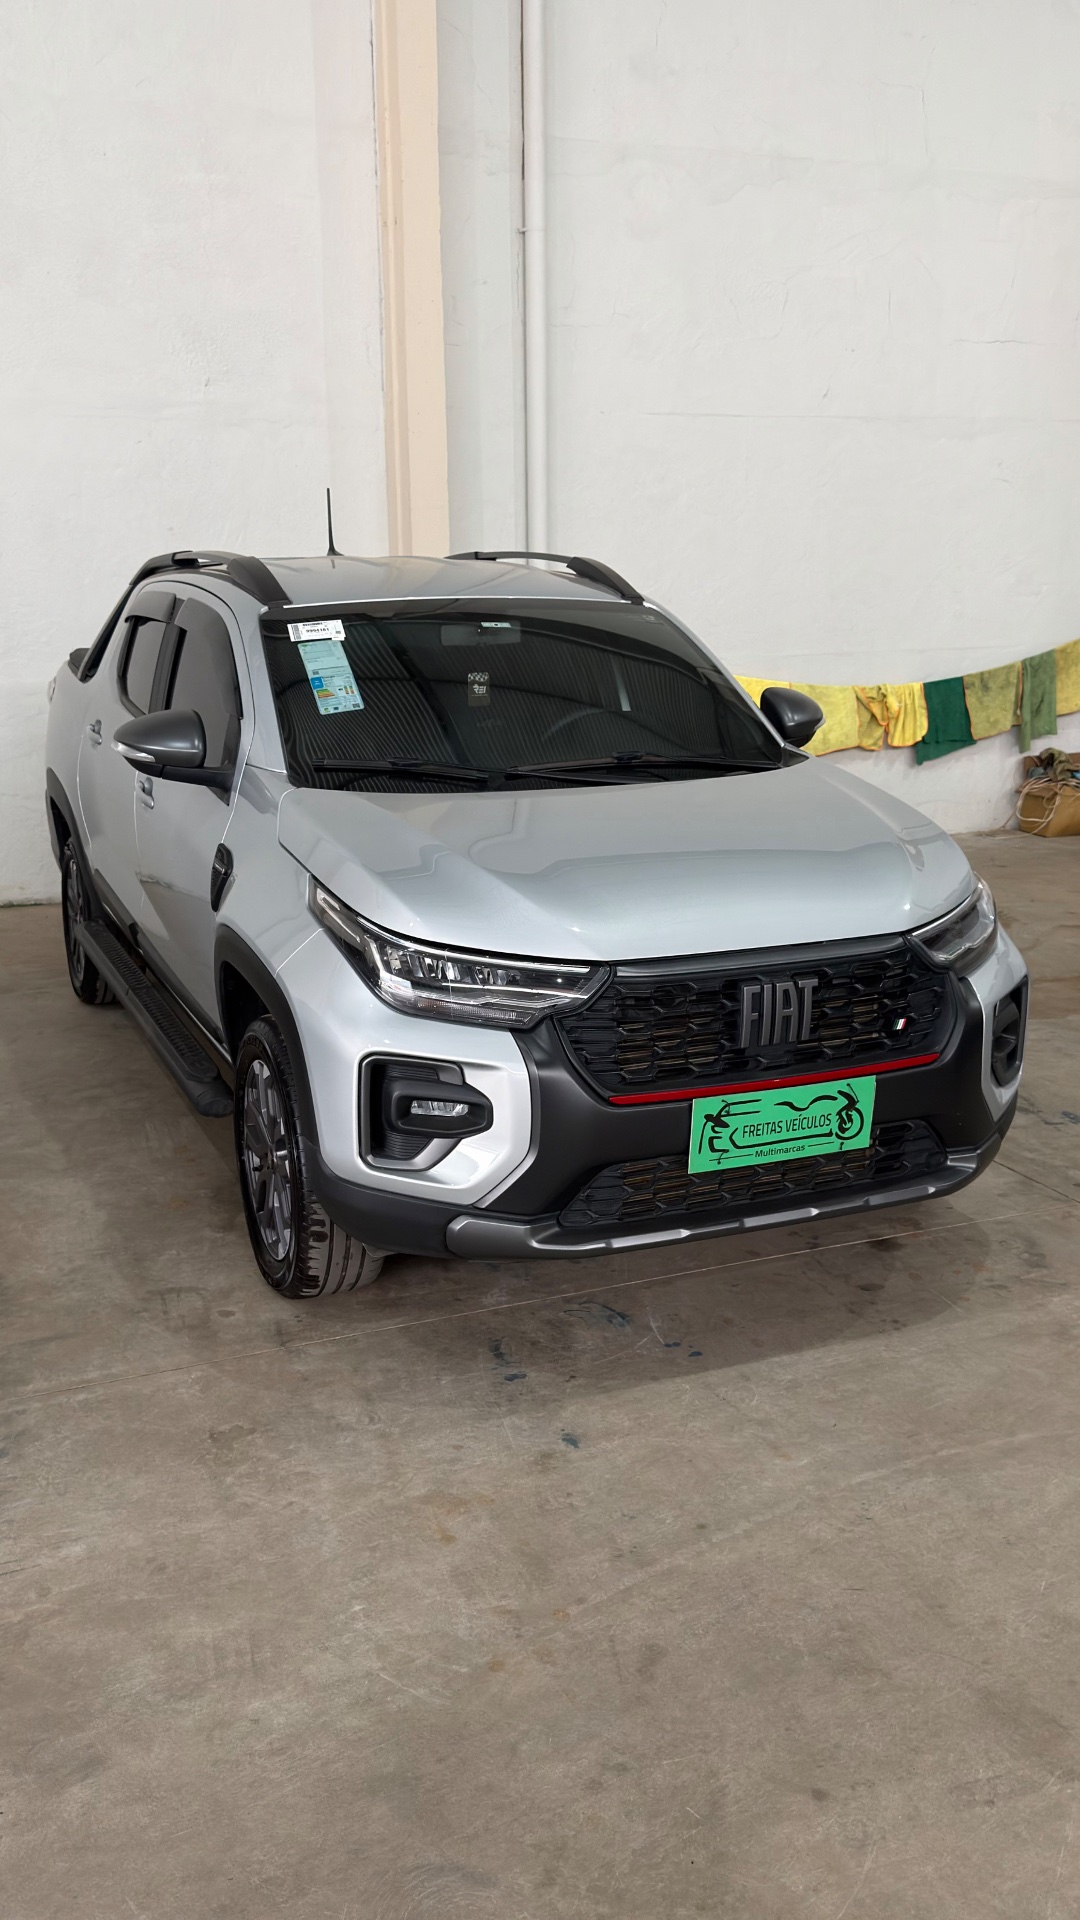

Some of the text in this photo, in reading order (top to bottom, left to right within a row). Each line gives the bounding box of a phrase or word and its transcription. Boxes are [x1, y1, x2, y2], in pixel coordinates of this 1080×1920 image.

[740, 978, 819, 1049] FIAT
[742, 1113, 832, 1138] FREITAS VEÍCULOS
[754, 1144, 806, 1158] Multimarcas
